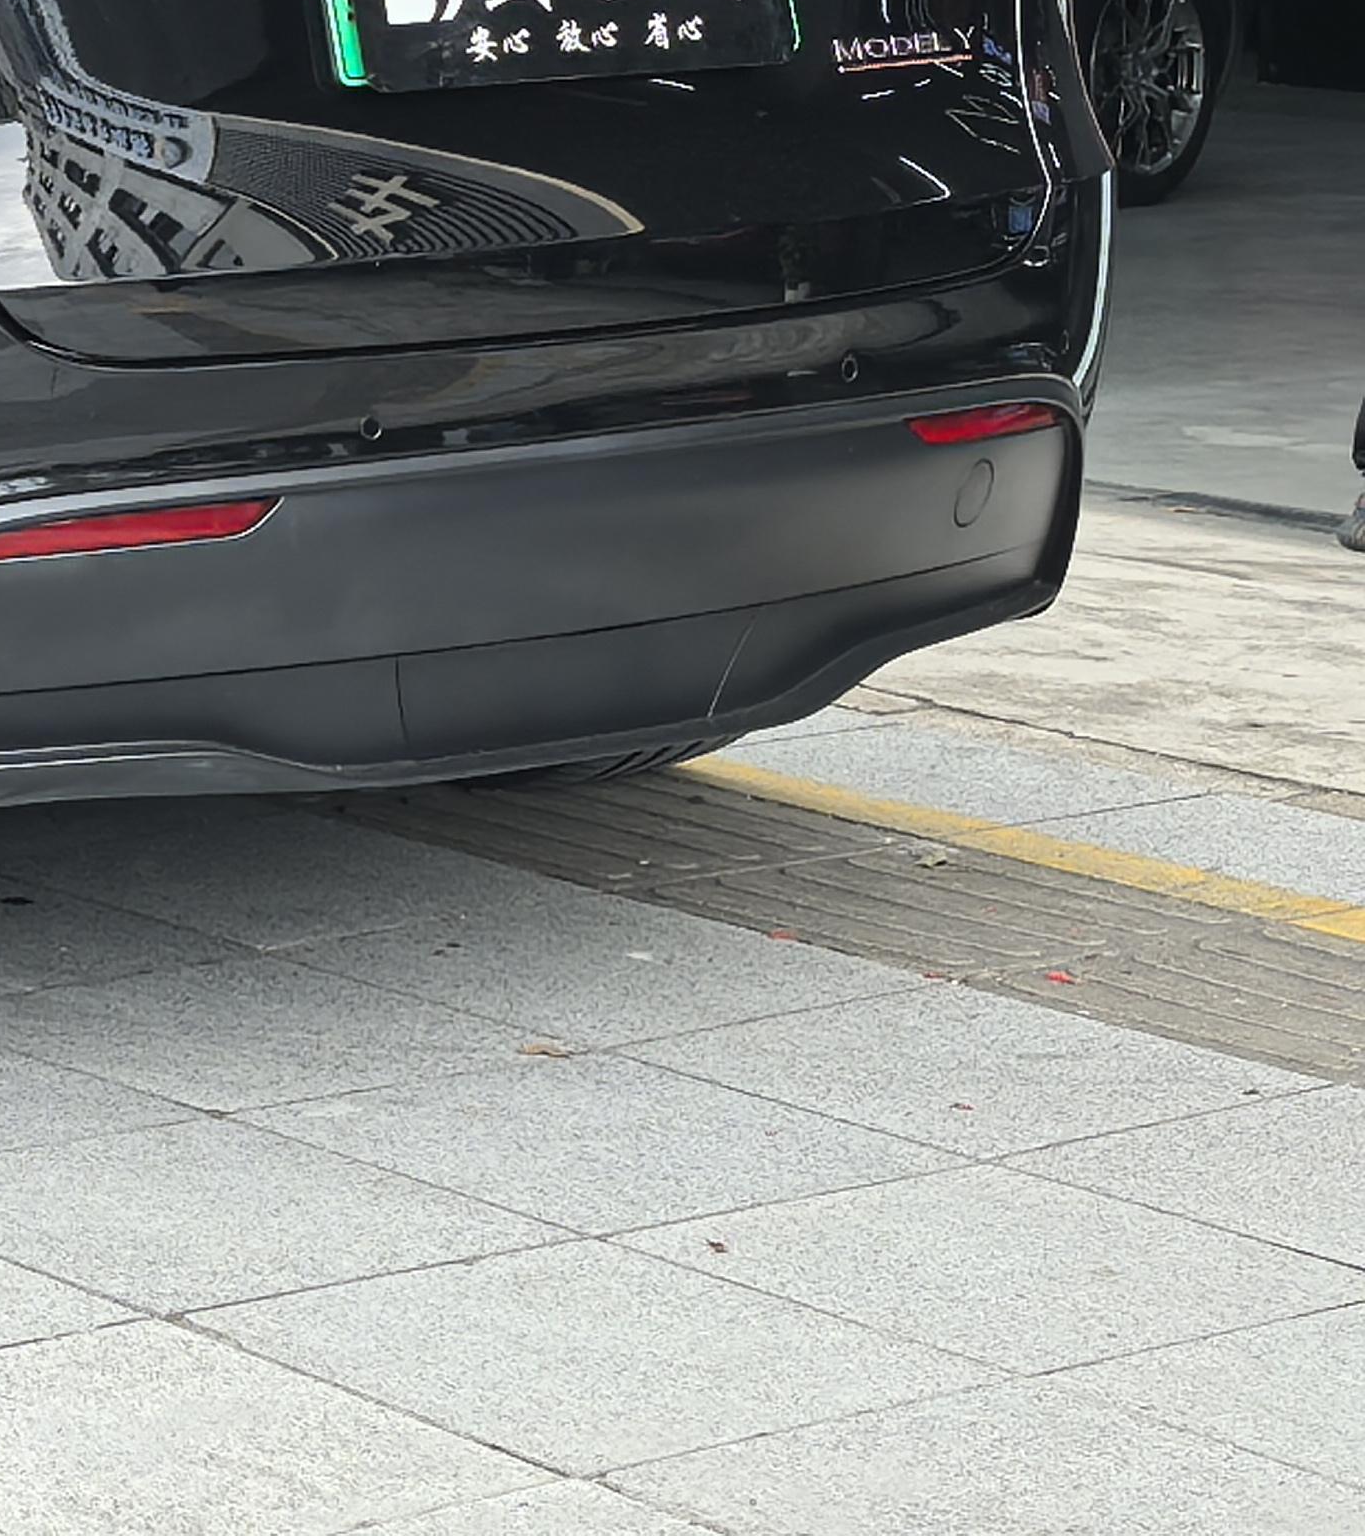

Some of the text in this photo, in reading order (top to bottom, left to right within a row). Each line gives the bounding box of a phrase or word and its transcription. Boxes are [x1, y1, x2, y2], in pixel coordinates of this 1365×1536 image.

[465, 12, 705, 63] 安心 放心 省心
[831, 26, 975, 63] MODEL Y
